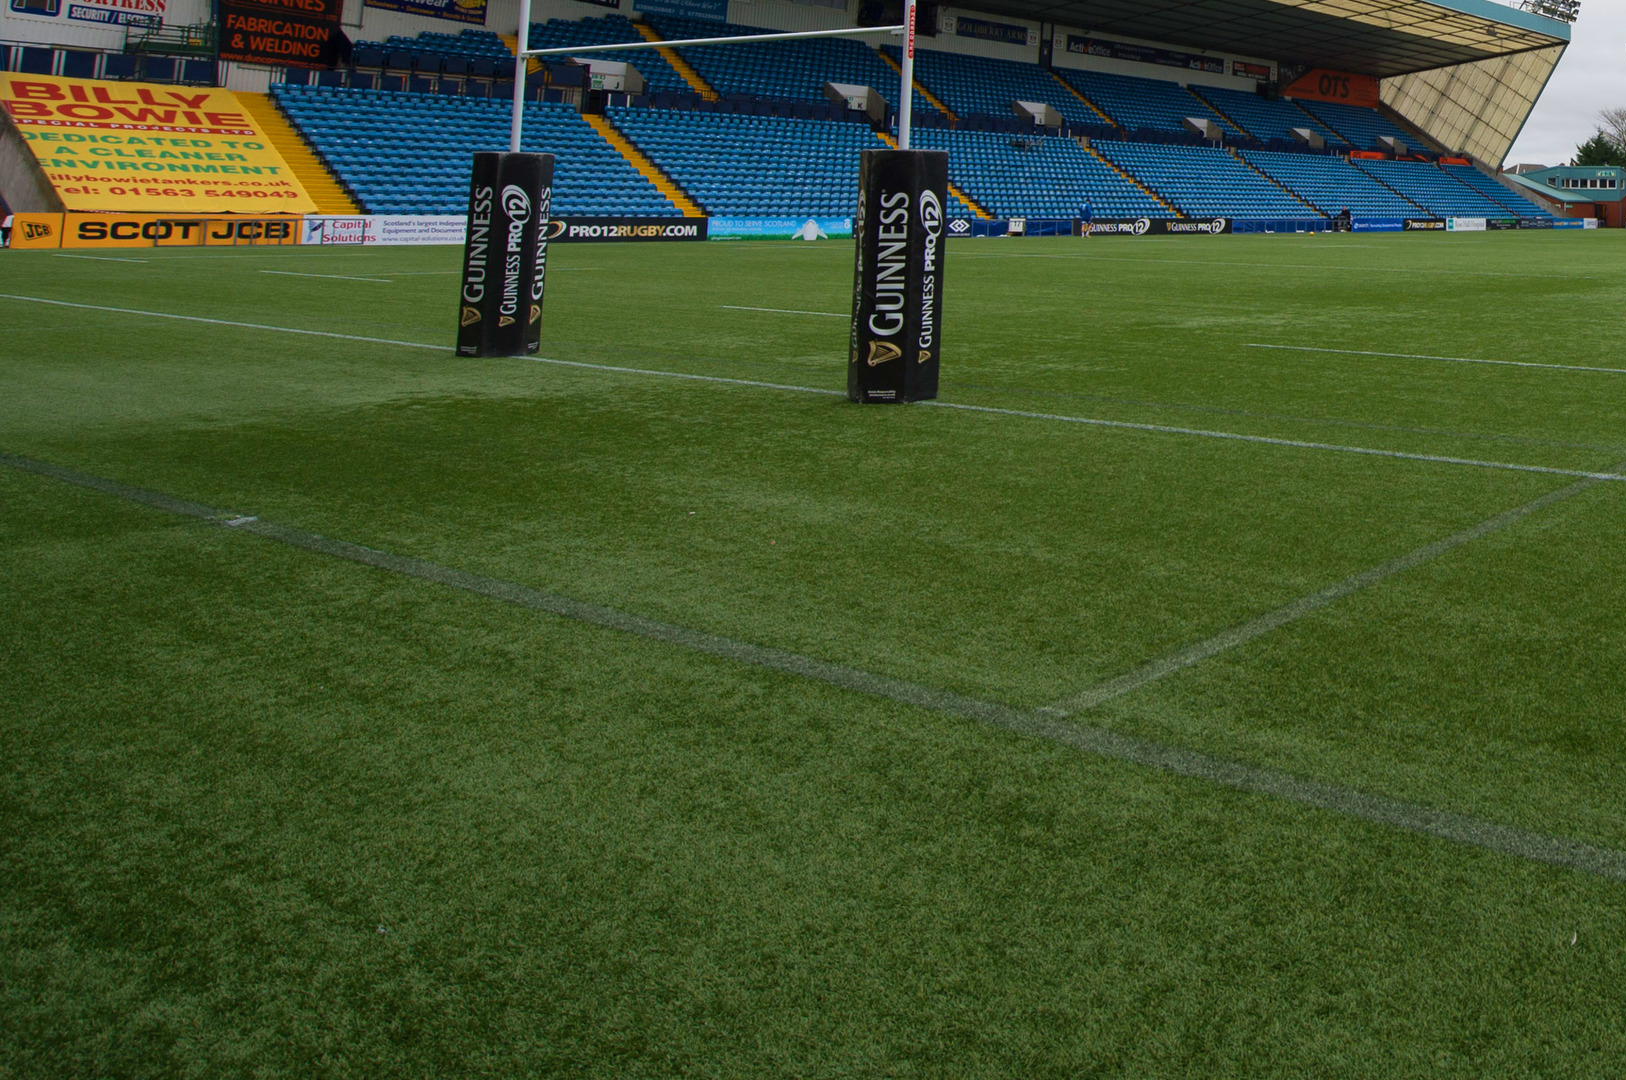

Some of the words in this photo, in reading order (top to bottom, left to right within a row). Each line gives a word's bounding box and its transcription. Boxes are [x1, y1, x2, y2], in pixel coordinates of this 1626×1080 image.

[71, 6, 110, 22] SECURITY
[226, 14, 330, 42] FABRICATION
[230, 33, 245, 49] &
[250, 36, 320, 58] WELDING
[1318, 73, 1350, 98] QTS
[10, 81, 211, 109] BILLY
[1, 100, 250, 128] BOWIE
[110, 124, 210, 134] PROJECTS
[20, 131, 212, 148] DEDICATED
[220, 140, 264, 150] TO
[54, 146, 78, 155] A
[88, 148, 248, 162] CLEANER
[38, 158, 281, 175] ENVIRONMENT
[50, 174, 292, 187] illybowietankers.co.uk
[109, 186, 196, 198] 01563
[205, 190, 298, 199] 549049
[26, 224, 50, 239] JCB
[78, 222, 200, 240] SCOT
[211, 222, 290, 240] JCB
[332, 220, 372, 230] Capital
[416, 220, 438, 228] largest
[568, 225, 698, 238] PRO12RUGBY.COM
[1090, 222, 1118, 232] GUINNESS
[1118, 222, 1145, 232] PRO12
[1172, 222, 1197, 232] GUINNESS
[1198, 222, 1220, 232] PRO12
[322, 234, 376, 242] Solutions
[463, 186, 493, 302] GUINNESS
[531, 186, 552, 300] GUINNESS
[868, 192, 910, 336] GUINNESS
[500, 254, 520, 314] GUINNESS
[918, 274, 935, 348] GUINNESS
